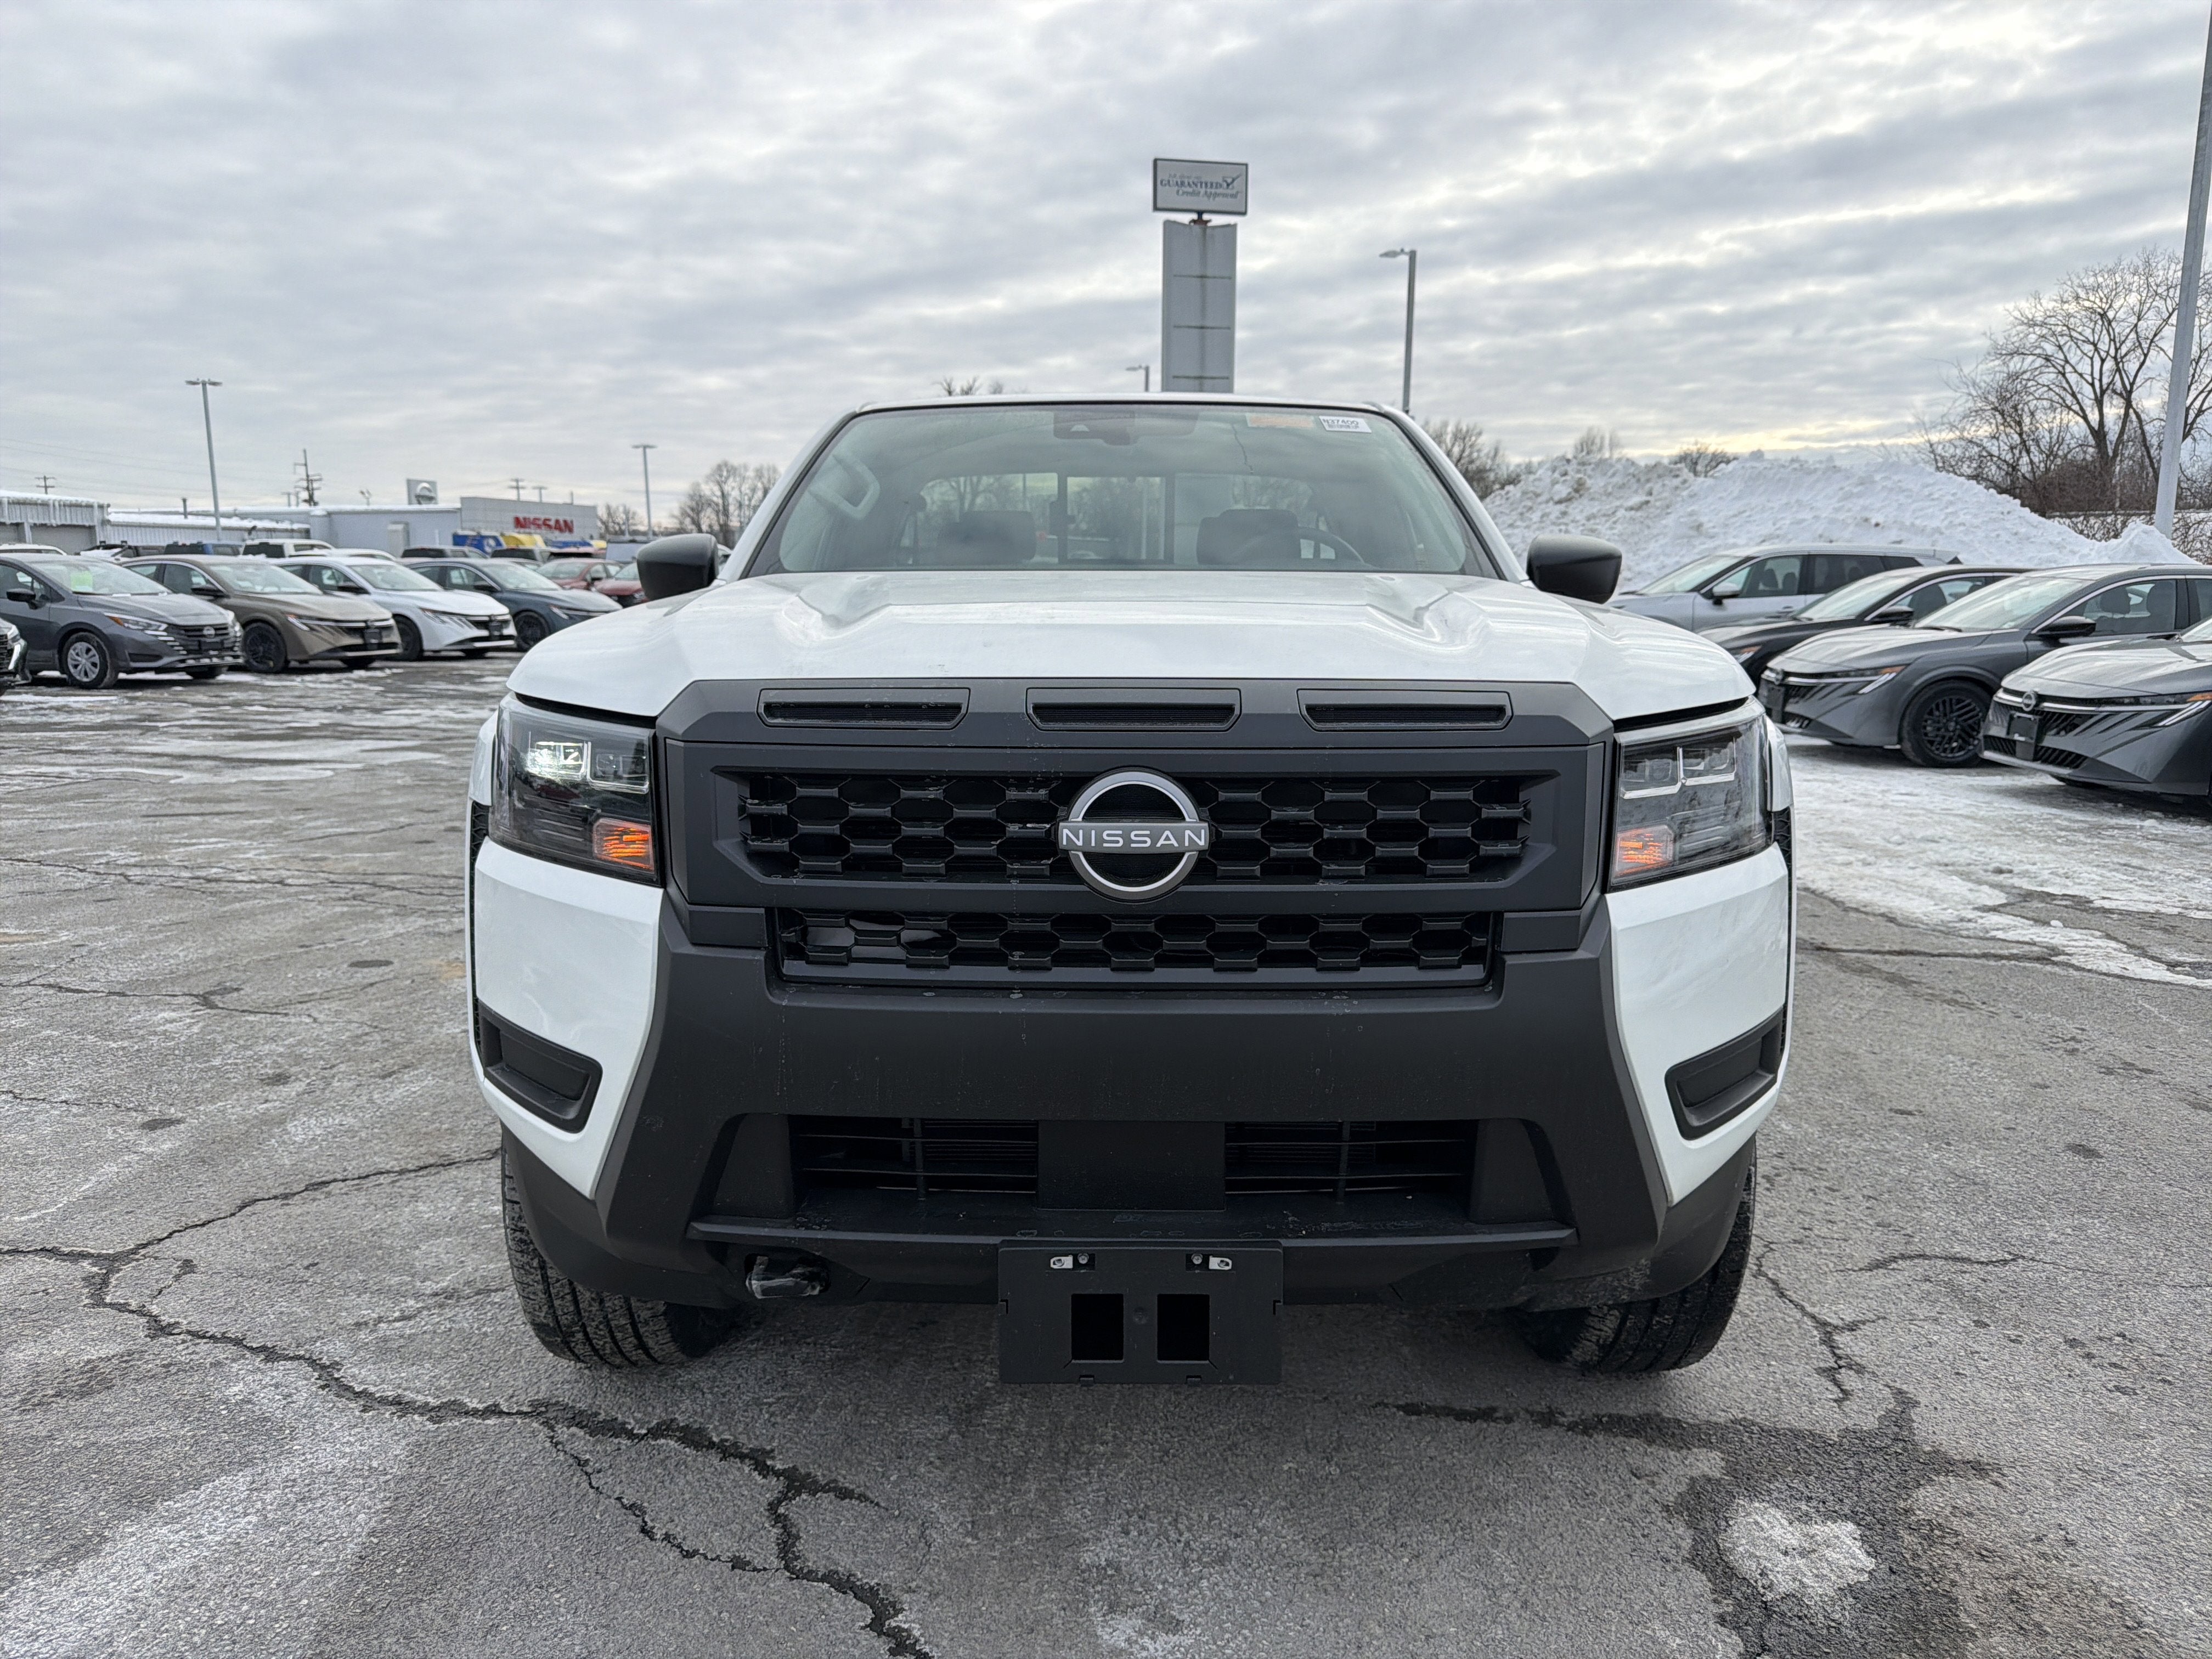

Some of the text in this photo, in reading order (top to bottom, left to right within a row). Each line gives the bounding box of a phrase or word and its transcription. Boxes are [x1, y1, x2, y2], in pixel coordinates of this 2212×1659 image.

[1160, 179, 1223, 189] GUARANTEED
[514, 516, 574, 533] NISSAN
[1062, 828, 1205, 847] NISSAN
